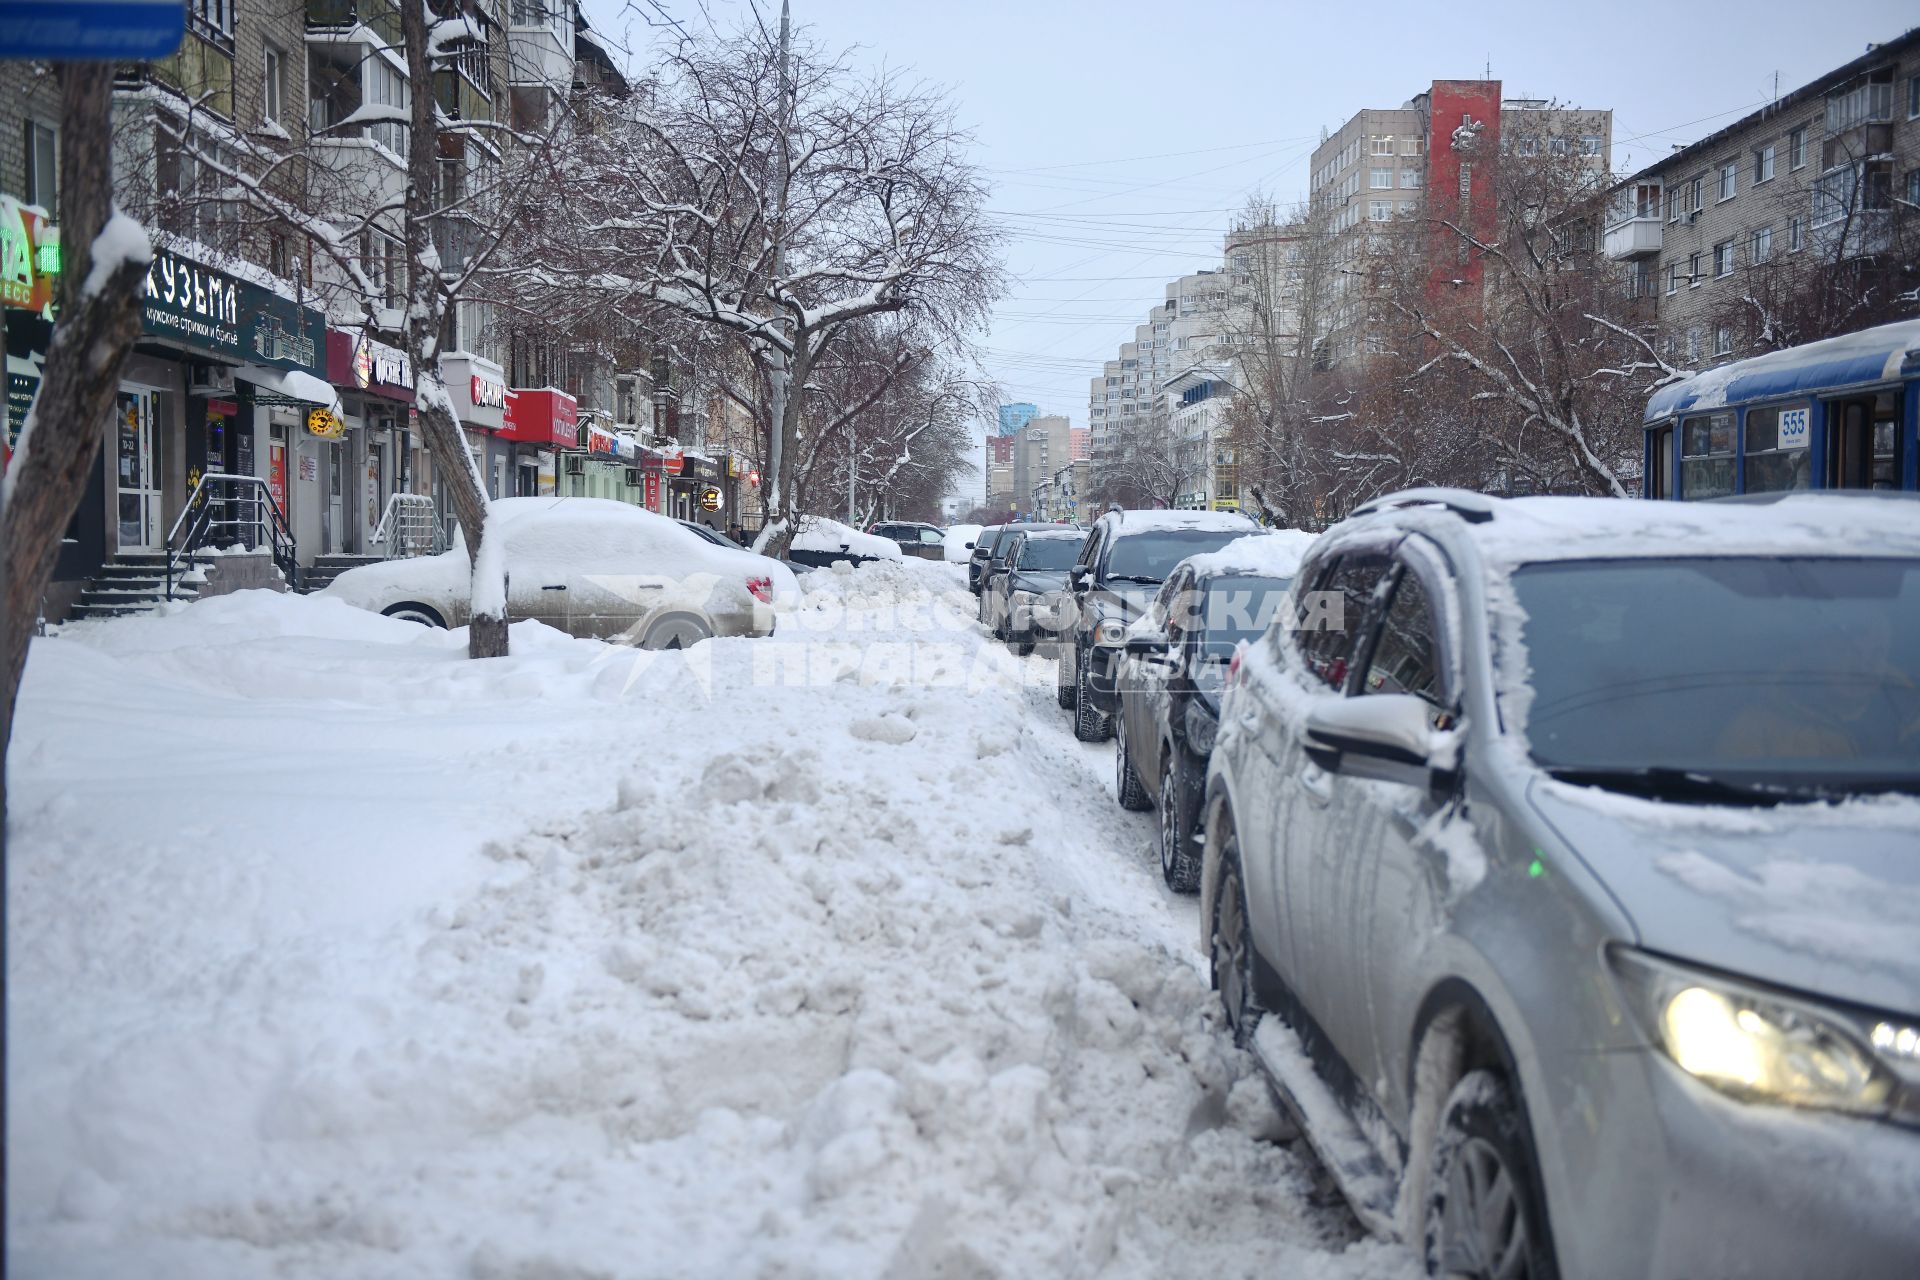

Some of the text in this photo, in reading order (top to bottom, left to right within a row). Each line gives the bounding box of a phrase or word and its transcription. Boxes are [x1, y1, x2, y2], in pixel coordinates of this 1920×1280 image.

[147, 253, 236, 325] КУЗЬМА
[146, 307, 179, 328] мужские
[180, 317, 209, 336] стрижки
[1782, 410, 1805, 436] 555
[649, 471, 658, 512] ЦВЕТЫ
